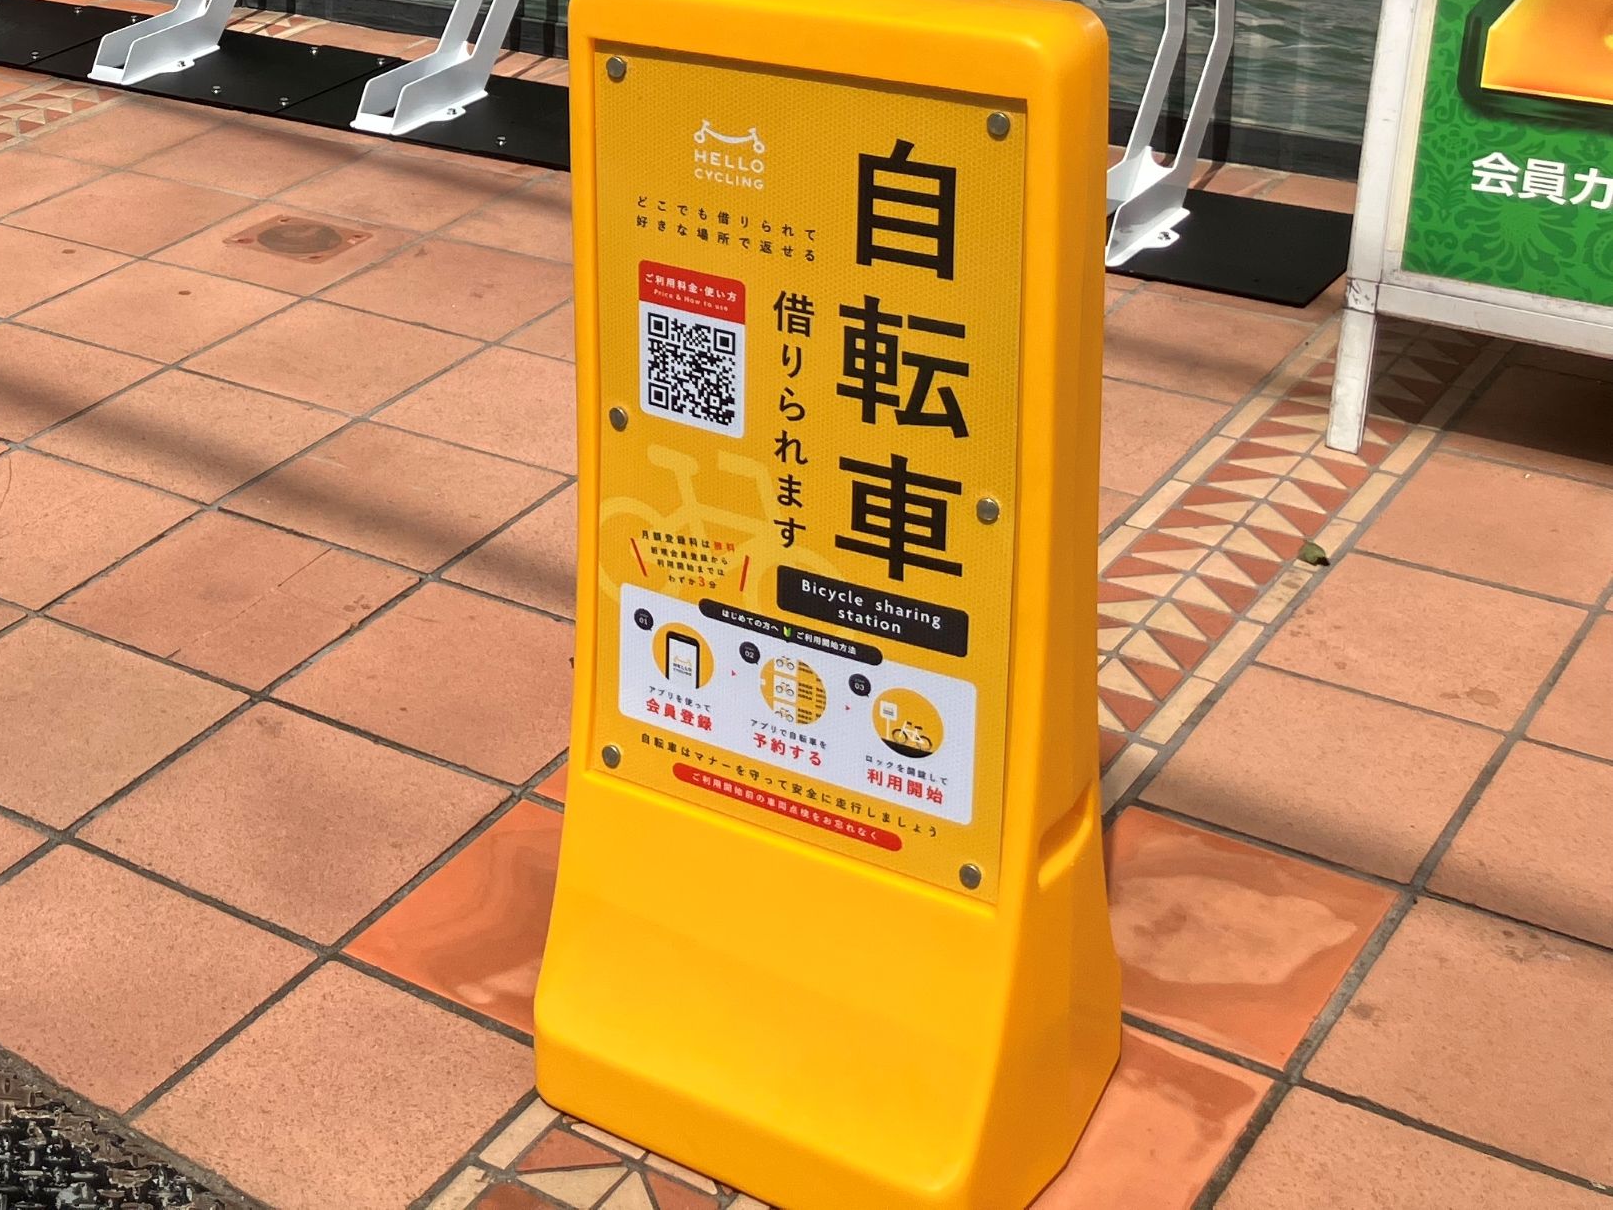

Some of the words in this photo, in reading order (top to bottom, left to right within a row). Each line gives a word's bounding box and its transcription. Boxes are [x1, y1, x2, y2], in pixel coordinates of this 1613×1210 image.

[694, 149, 765, 174] HELLO
[694, 168, 765, 190] CYCLING
[637, 195, 817, 242] どこでも借りられて
[636, 214, 816, 263] 好きな場所で返せる
[653, 288, 673, 300] Price
[714, 303, 729, 312] use
[834, 138, 970, 582] 自転車
[773, 290, 815, 548] 借りられます
[801, 578, 864, 607] Bicycle
[875, 600, 942, 630] sharing
[838, 607, 902, 635] station
[721, 609, 779, 633] はじめての方へ
[796, 631, 857, 655] ご利用開始方法
[744, 650, 755, 659] 02
[648, 685, 712, 712] アプリを使って
[854, 682, 865, 691] 03
[645, 697, 713, 732] 会員登録
[750, 718, 827, 750] アプリで自転車を
[753, 732, 822, 767] 予約する
[641, 733, 937, 838] 自転車はマナーを守って安全に走行しましょう
[867, 768, 944, 805] 利用開始
